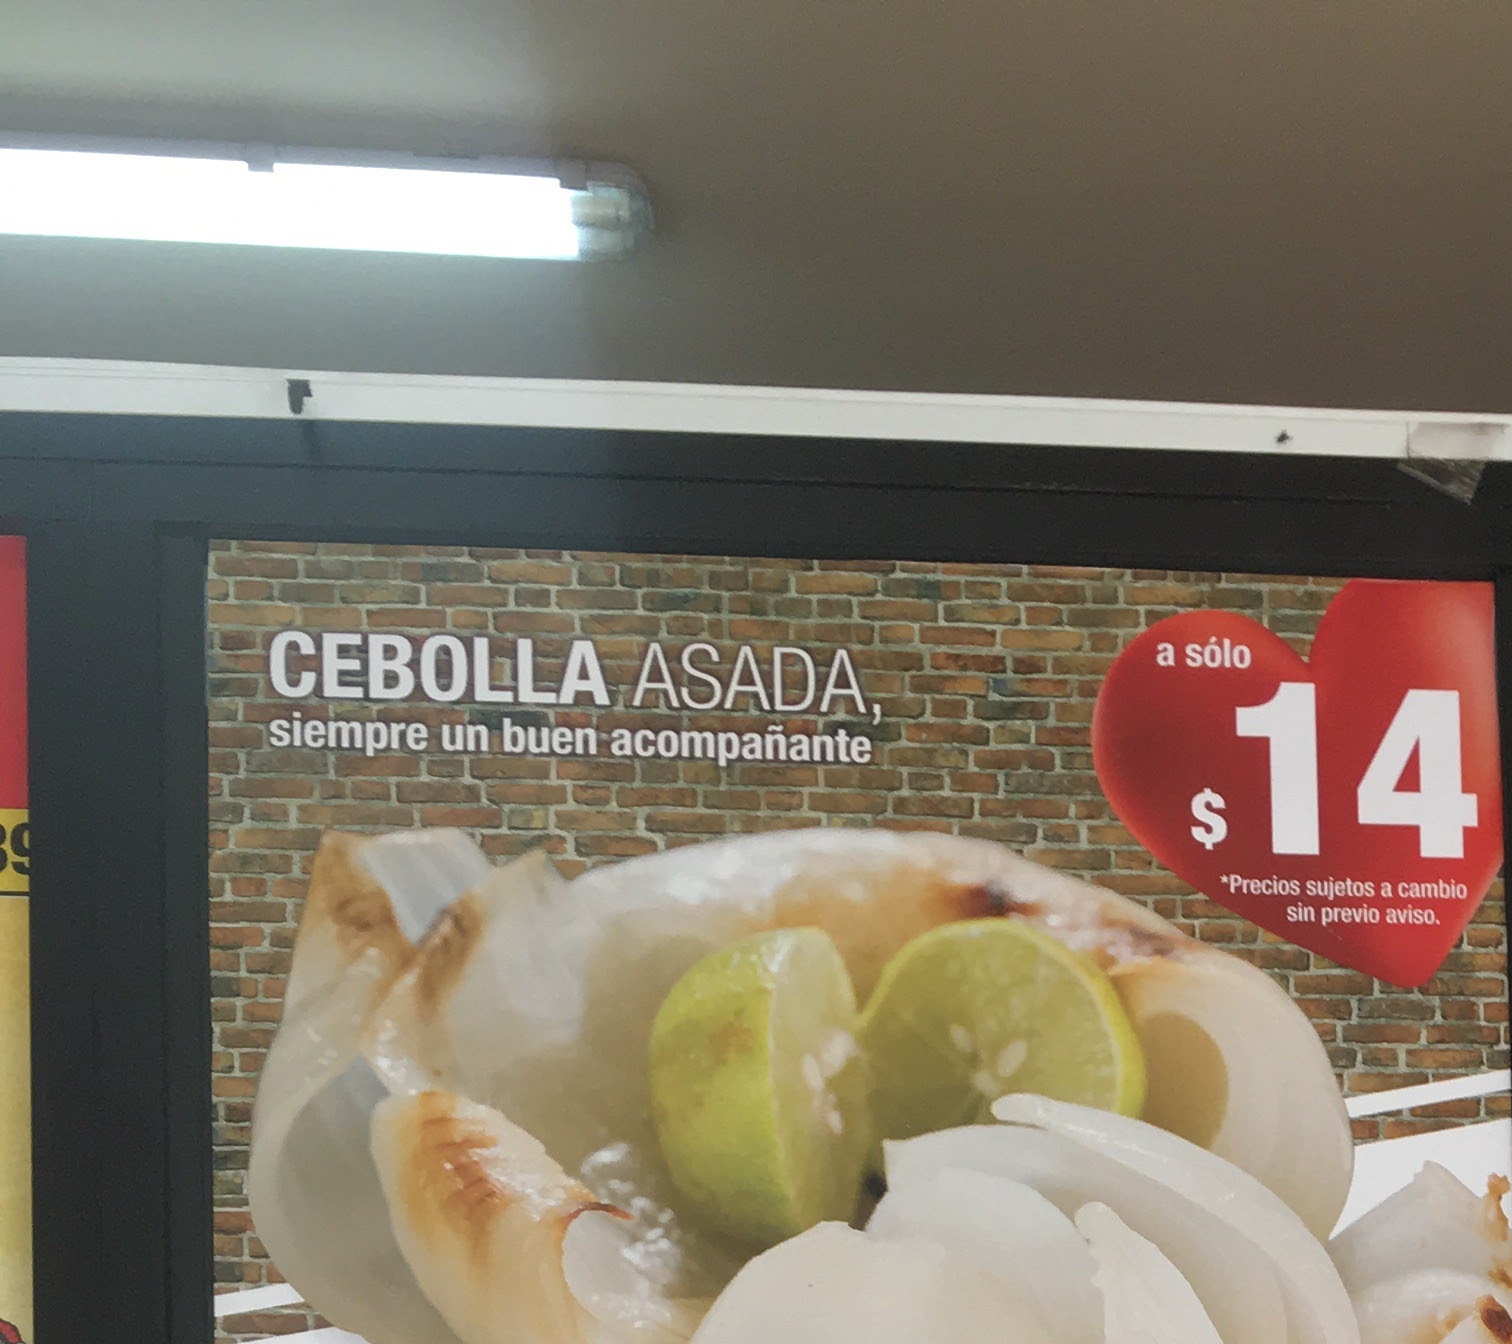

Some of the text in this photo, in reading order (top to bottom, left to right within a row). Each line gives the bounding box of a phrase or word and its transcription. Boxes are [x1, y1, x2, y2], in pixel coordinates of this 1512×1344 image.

[1156, 636, 1251, 669] a sólo
[268, 630, 882, 724] CEBOLLA ASADA,
[269, 711, 872, 766] siempre un buen acompañante
[1305, 878, 1374, 900] sujetos
[1380, 883, 1392, 898] a
[1398, 879, 1467, 900] cambio
[1286, 904, 1441, 927] sin previo aviso.
